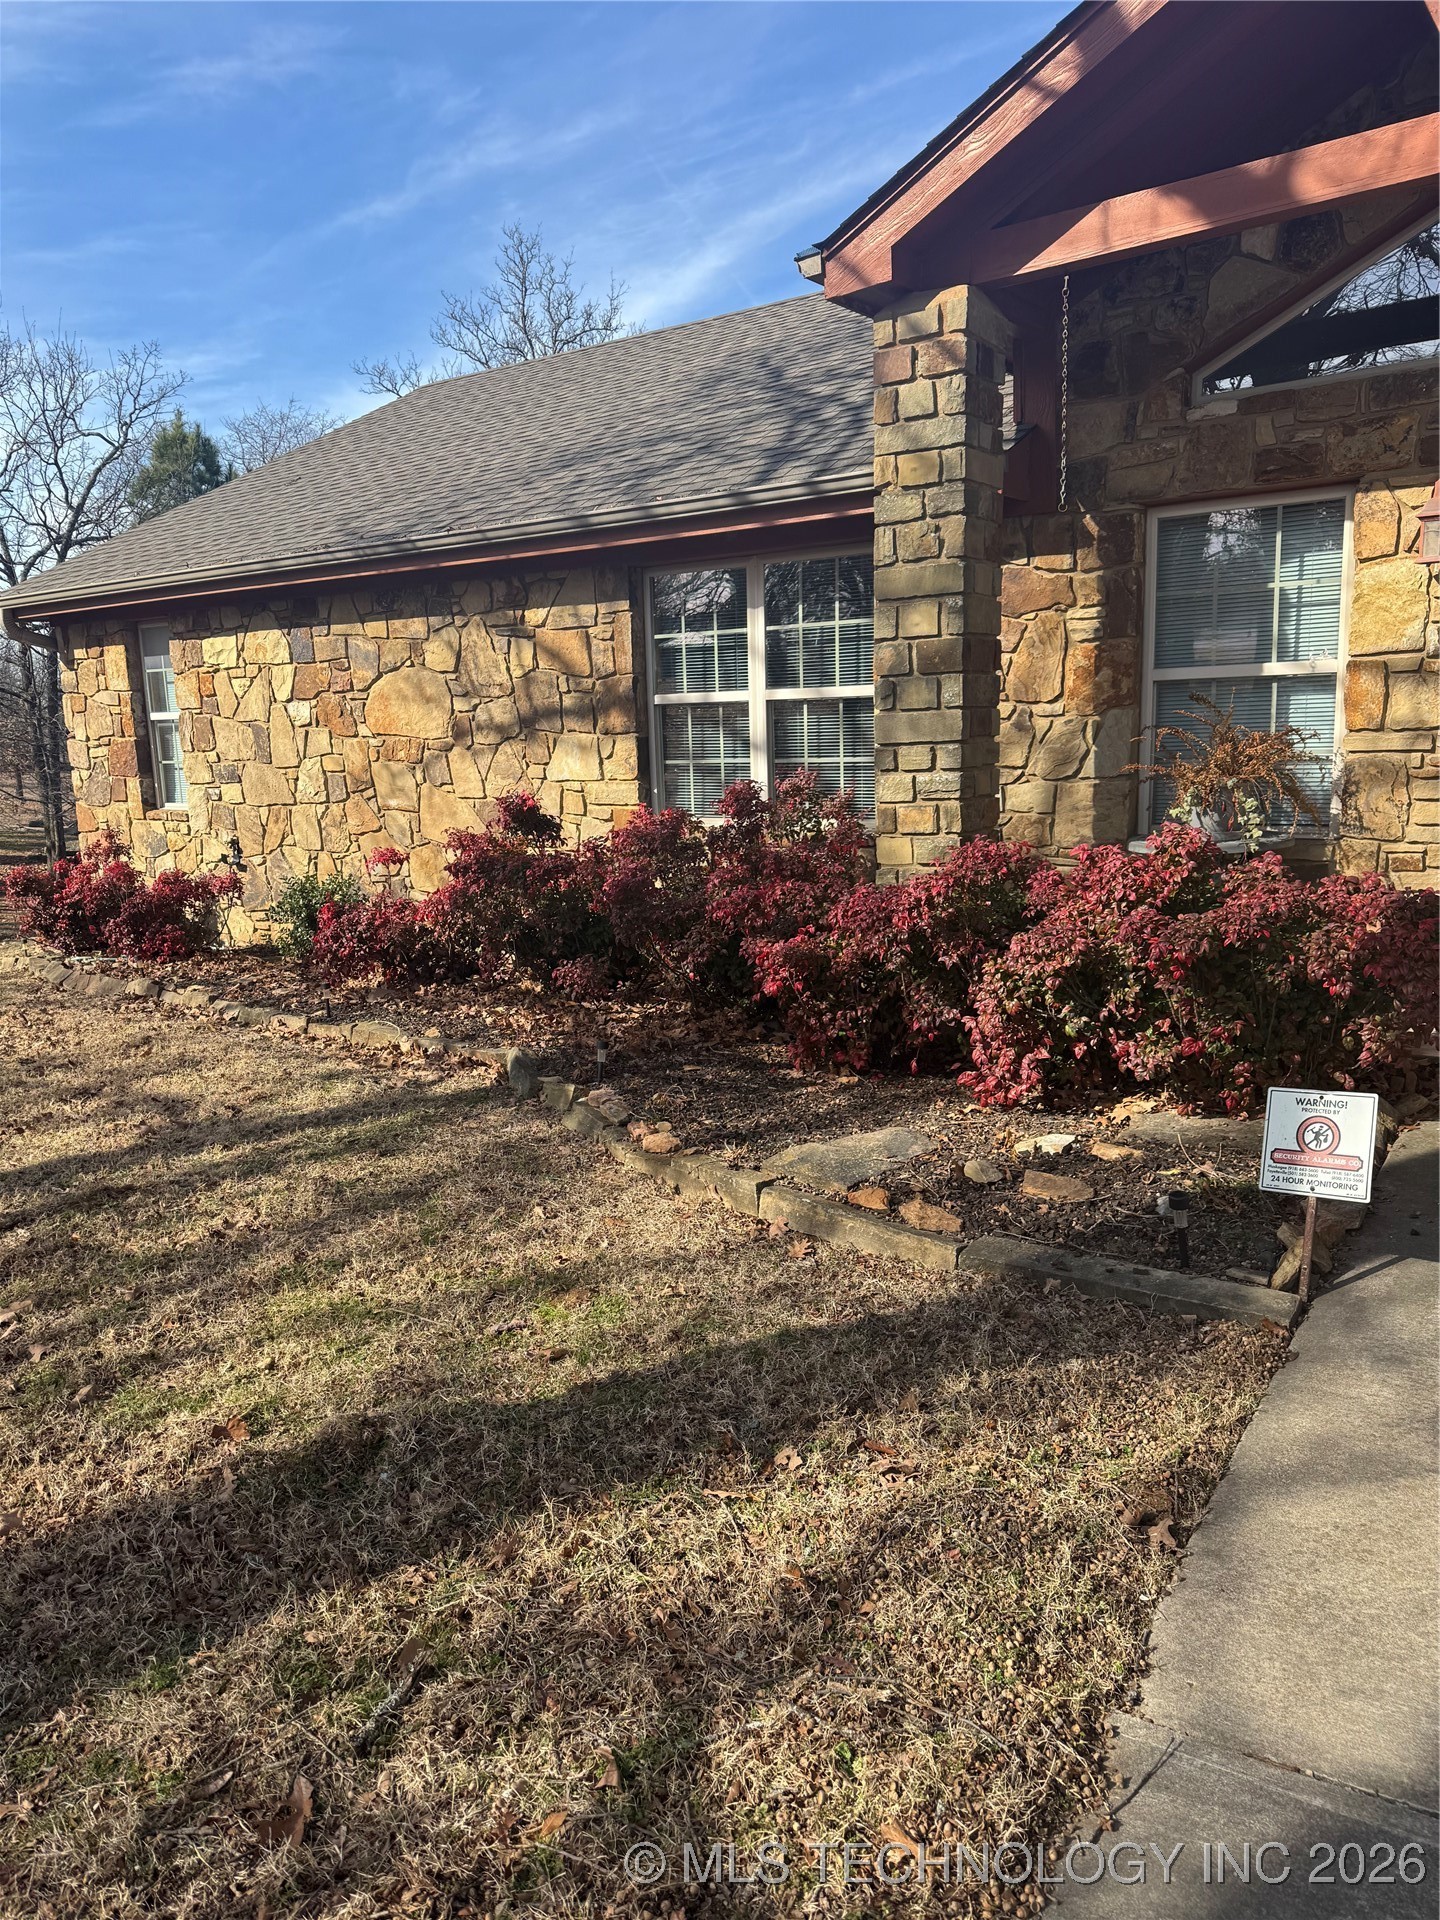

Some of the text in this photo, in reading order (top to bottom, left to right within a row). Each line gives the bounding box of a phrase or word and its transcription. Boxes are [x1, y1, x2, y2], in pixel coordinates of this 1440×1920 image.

[1295, 1097, 1348, 1109] WARNING!
[1273, 1152, 1309, 1161] SECURITY
[1312, 1156, 1346, 1165] ALARMS
[1270, 1174, 1359, 1191] 24 HOUR MONITORING
